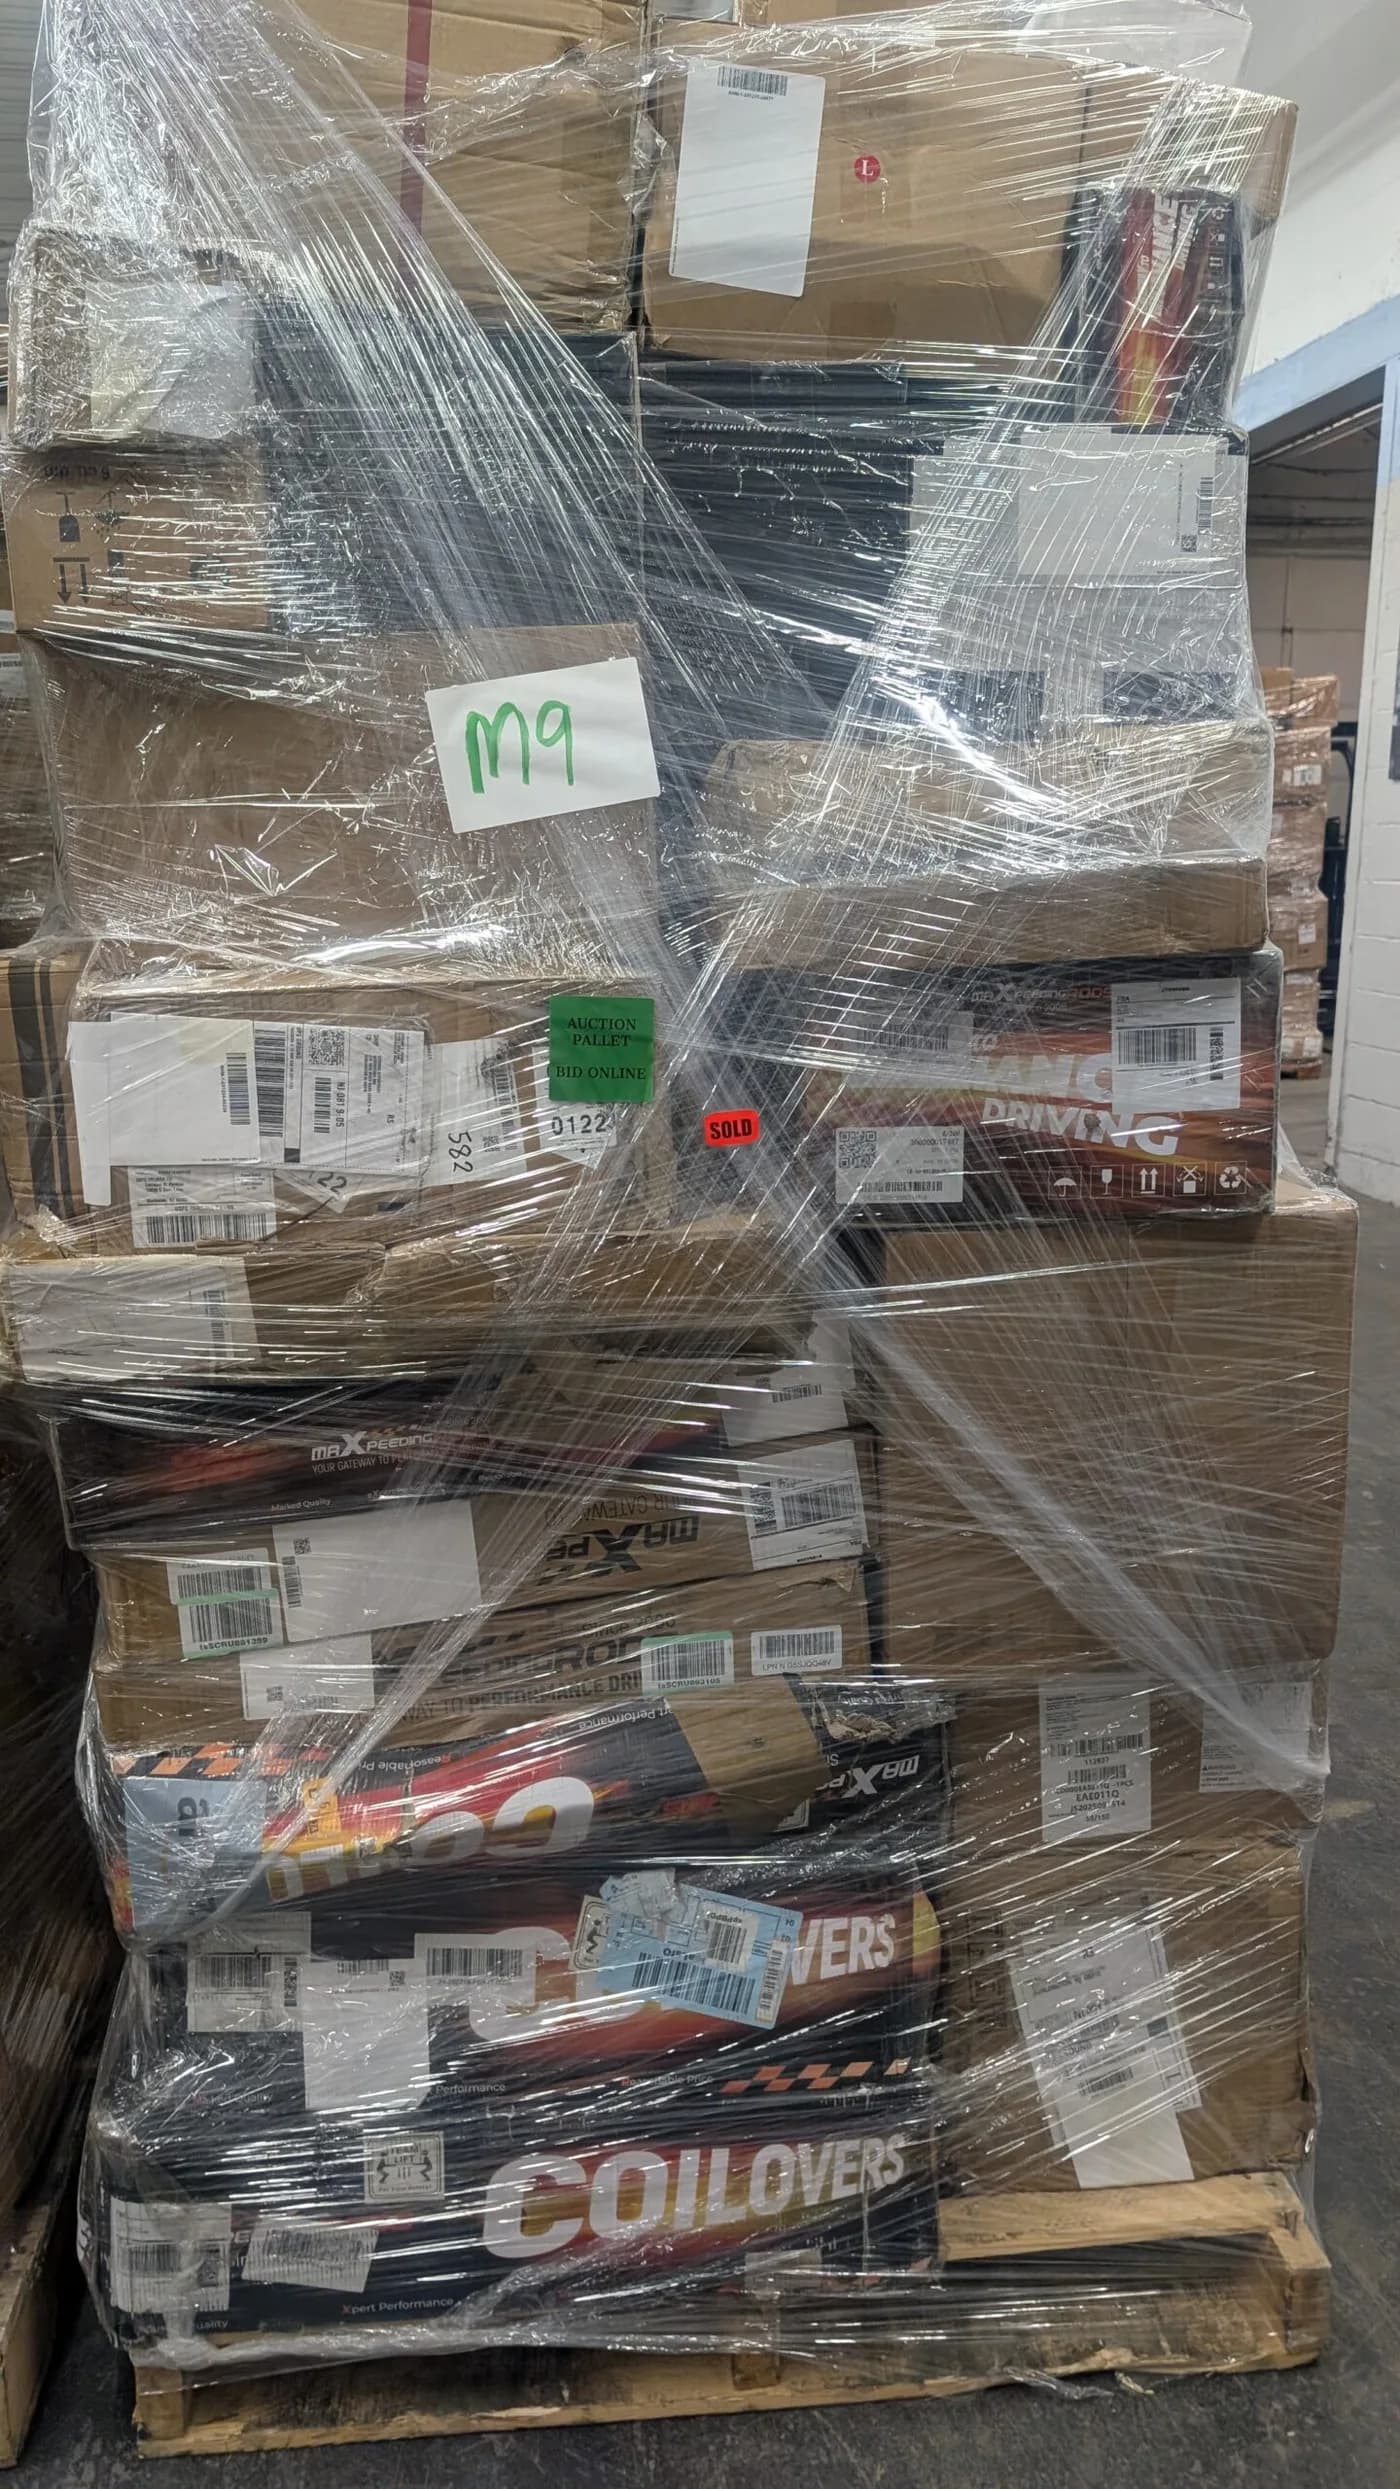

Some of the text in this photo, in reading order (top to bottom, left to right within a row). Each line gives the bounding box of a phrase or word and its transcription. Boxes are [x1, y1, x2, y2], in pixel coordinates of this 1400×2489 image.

[861, 159, 874, 177] L
[465, 699, 575, 794] M9
[567, 1017, 637, 1031] AUCTION
[573, 1033, 632, 1047] PALLET
[556, 1065, 647, 1080] BID ONLINE
[709, 1118, 753, 1140] SOLD
[980, 1097, 1179, 1156] DRIVING
[447, 1131, 474, 1173] 582
[312, 1171, 348, 1194] 22
[311, 1431, 433, 1461] MAXPEEDING
[311, 1463, 336, 1475] YOUR
[337, 1459, 377, 1472] GATEWAY
[577, 1709, 656, 1732] Performance
[435, 2082, 507, 2096] Performance
[482, 2133, 905, 2259] COILOVERS
[343, 2296, 455, 2316] Xpert Performance
[196, 2317, 230, 2332] uality
